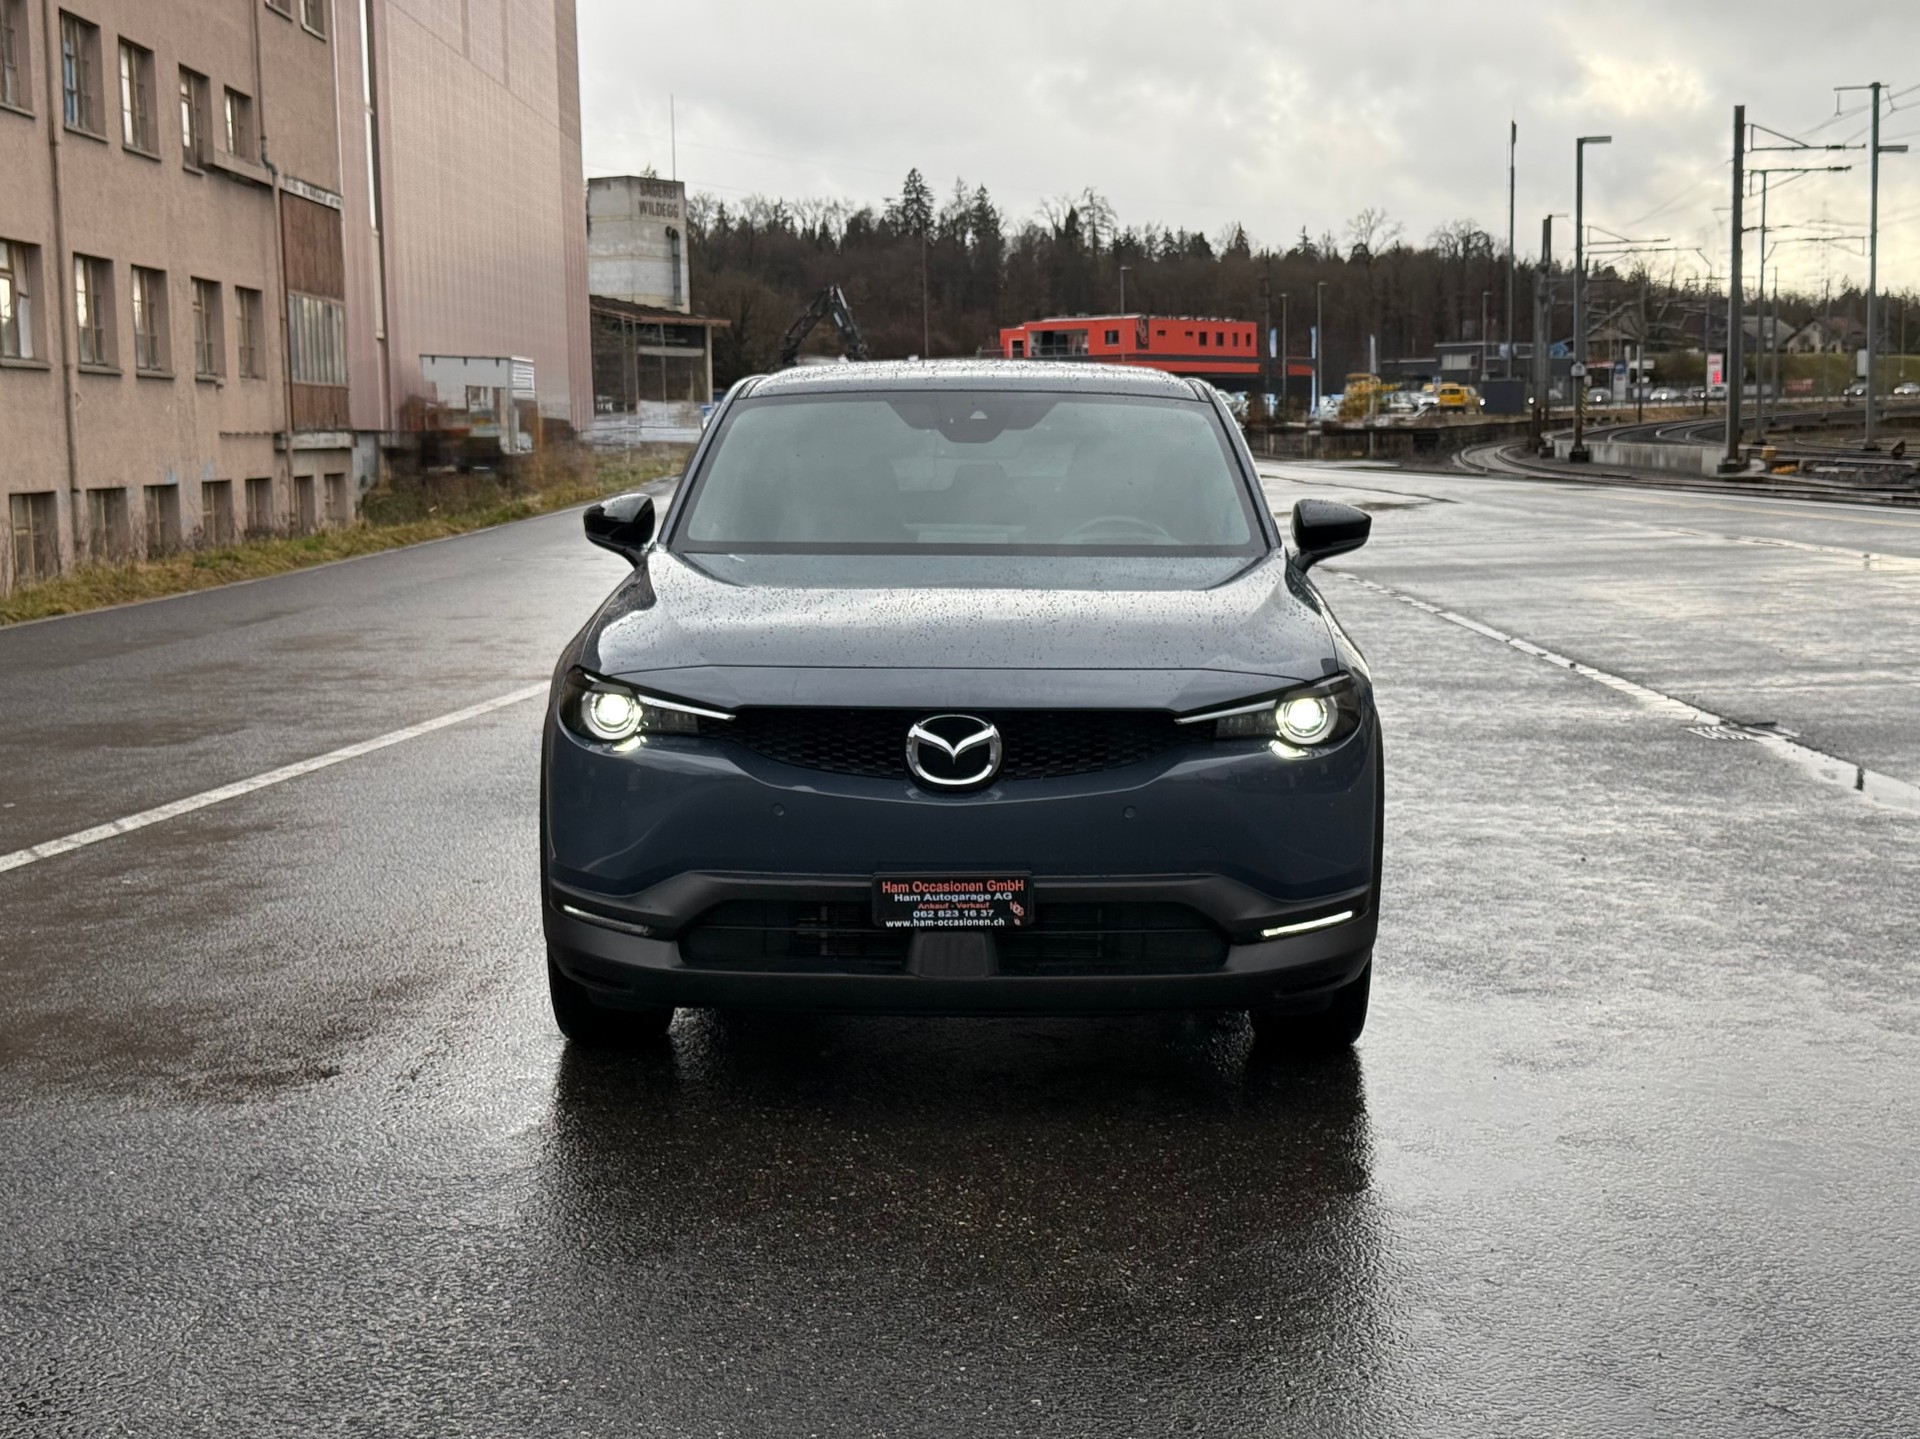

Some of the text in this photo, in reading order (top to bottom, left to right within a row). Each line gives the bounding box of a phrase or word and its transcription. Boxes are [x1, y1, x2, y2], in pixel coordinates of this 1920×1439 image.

[639, 201, 679, 218] WILDEGG
[882, 879, 1024, 893] Ham Occasionen GmbH
[894, 892, 1013, 903] Ham Autogarage AG
[913, 909, 995, 918] 062 823 16 37
[886, 917, 1005, 928] www.ham-occasionen.ch
